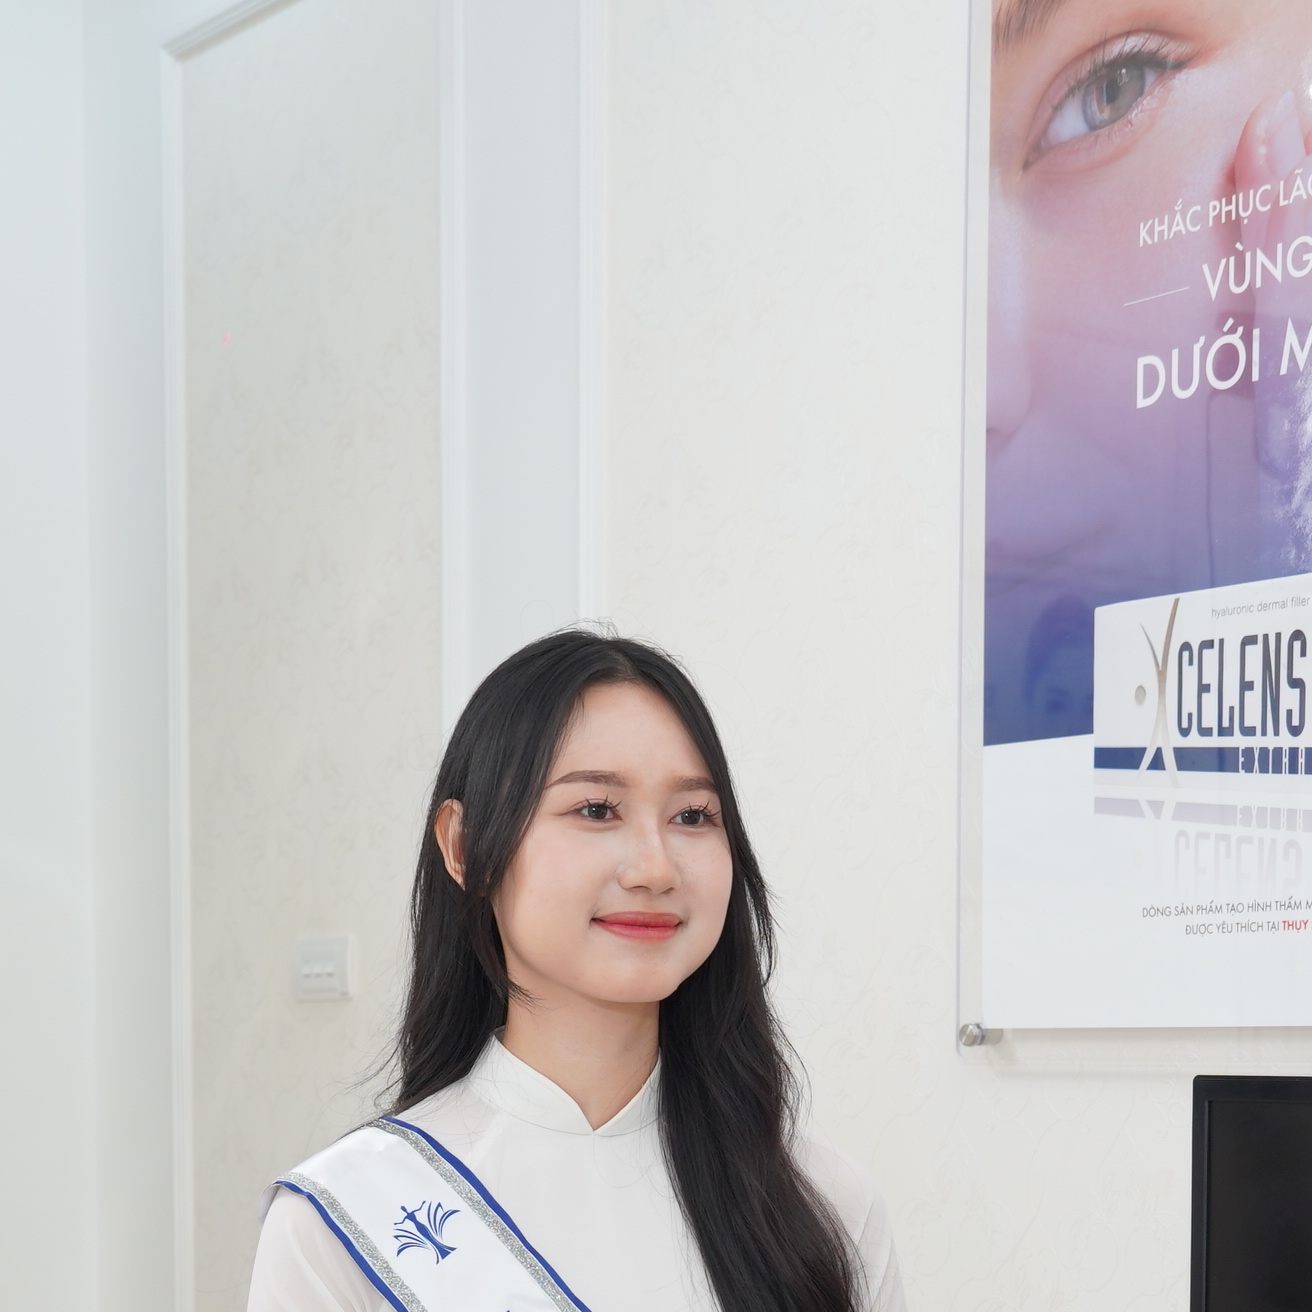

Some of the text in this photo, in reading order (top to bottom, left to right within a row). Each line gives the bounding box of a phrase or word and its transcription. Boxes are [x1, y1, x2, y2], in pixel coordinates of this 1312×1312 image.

[1139, 198, 1201, 247] KHẮC
[1208, 183, 1271, 225] PHỤC
[1136, 317, 1260, 409] DƯỚI
[1211, 594, 1311, 619] hyaluronic dermal filler
[1142, 903, 1172, 918] DÒNG
[1174, 901, 1194, 917] SẢN
[1196, 899, 1223, 916] PHẨM
[1226, 903, 1245, 917] TẠO
[1247, 898, 1272, 913] HÌNH
[1275, 895, 1303, 911] THẨM
[1185, 923, 1215, 937] ĐƯỢC
[1216, 920, 1233, 934] YÊU
[1236, 919, 1264, 934] THÍCH
[1267, 920, 1280, 935] TẠI
[1282, 918, 1309, 934] THỤY
